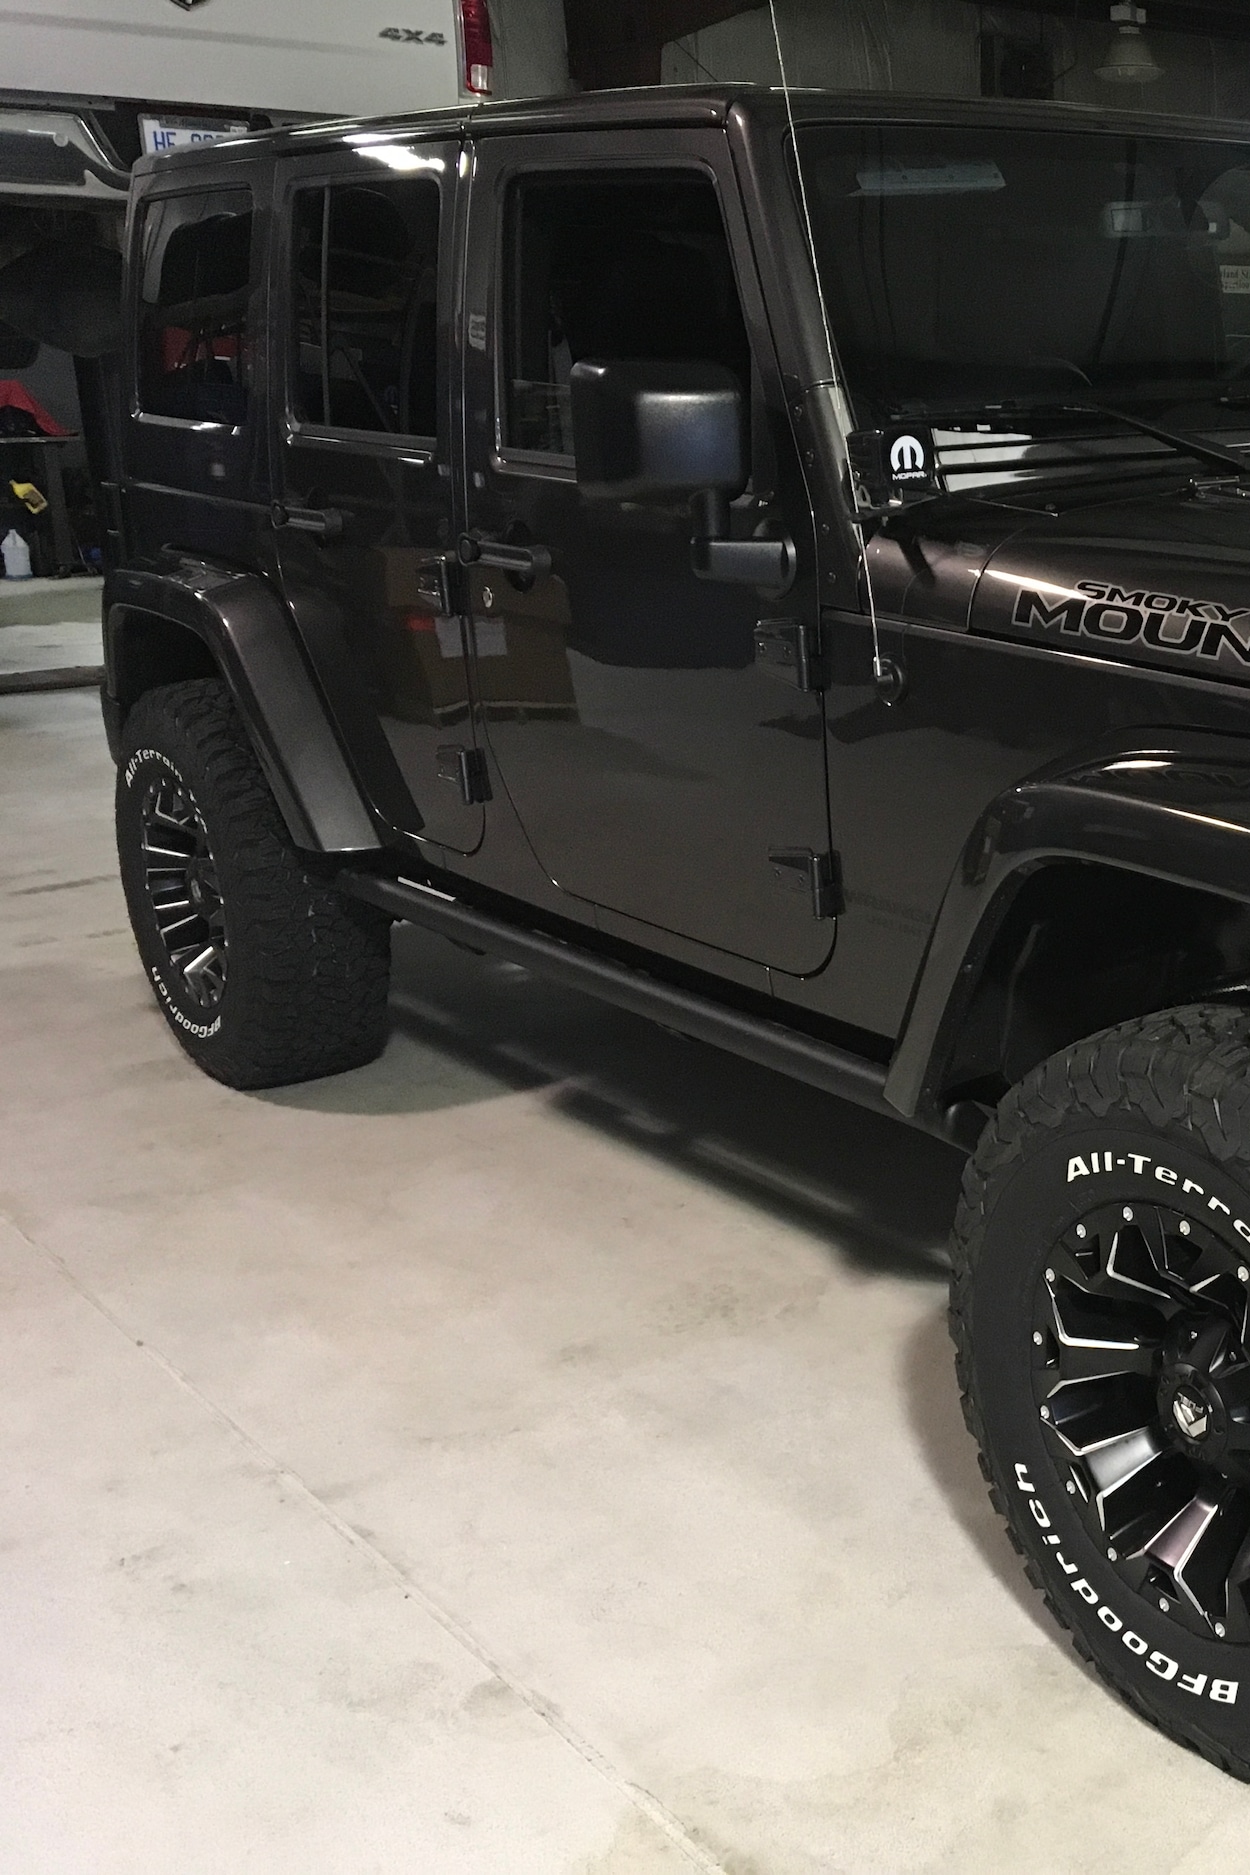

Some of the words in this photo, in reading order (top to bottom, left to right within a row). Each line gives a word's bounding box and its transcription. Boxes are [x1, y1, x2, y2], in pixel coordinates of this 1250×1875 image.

[378, 27, 448, 47] 4X4
[892, 470, 926, 481] MOPAR
[124, 749, 184, 788] All-Terrain
[1014, 1462, 1240, 1705] BFGoodrich
